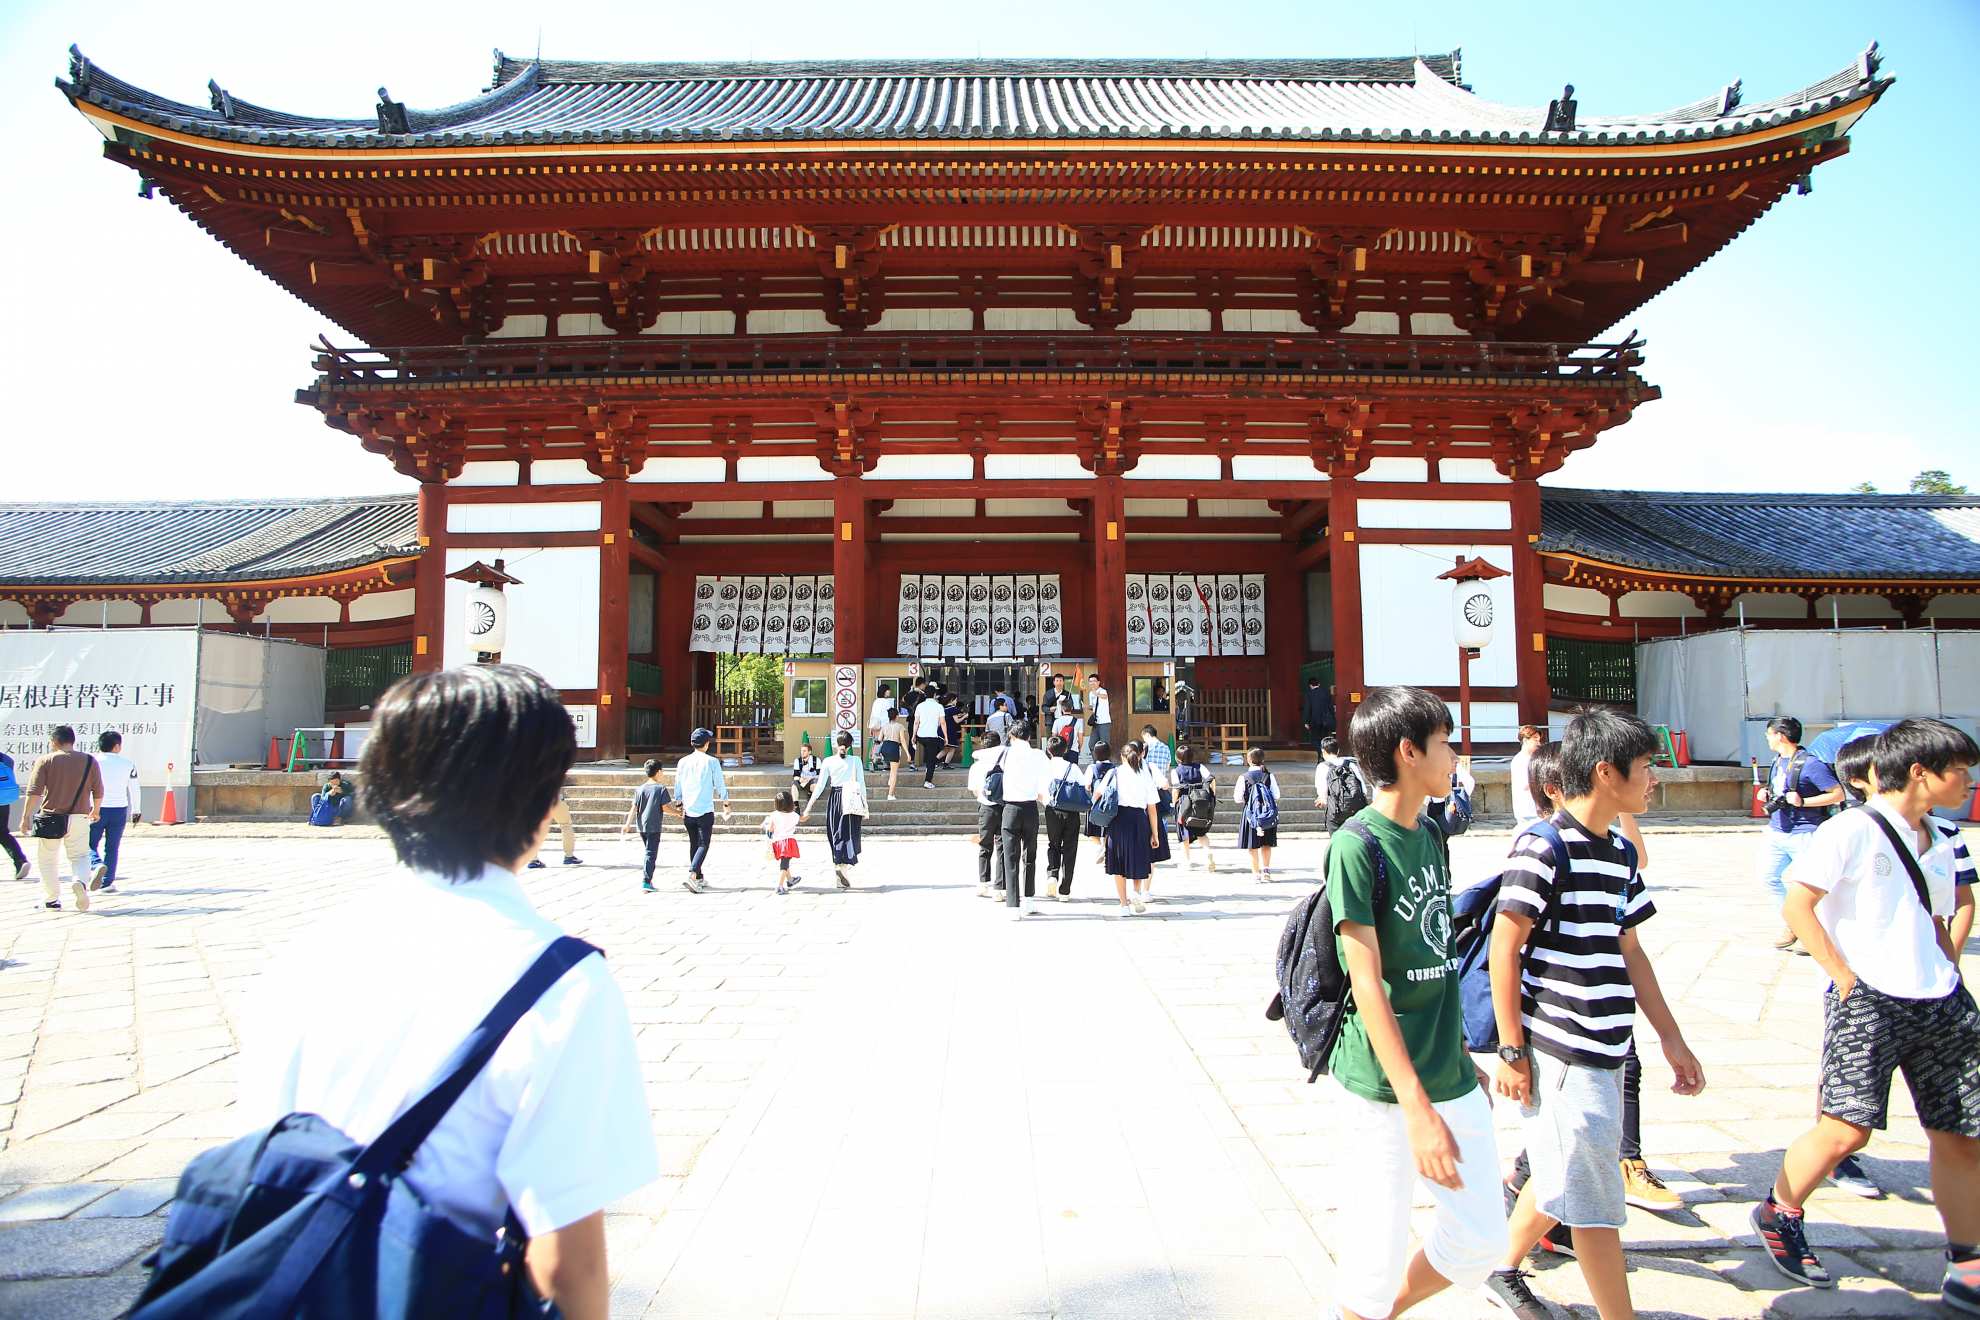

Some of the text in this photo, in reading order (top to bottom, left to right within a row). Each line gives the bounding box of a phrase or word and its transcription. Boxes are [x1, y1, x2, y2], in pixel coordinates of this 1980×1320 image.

[785, 662, 795, 675] 4
[909, 662, 918, 675] 3
[1041, 662, 1050, 675] 2
[1166, 662, 1171, 674] 1
